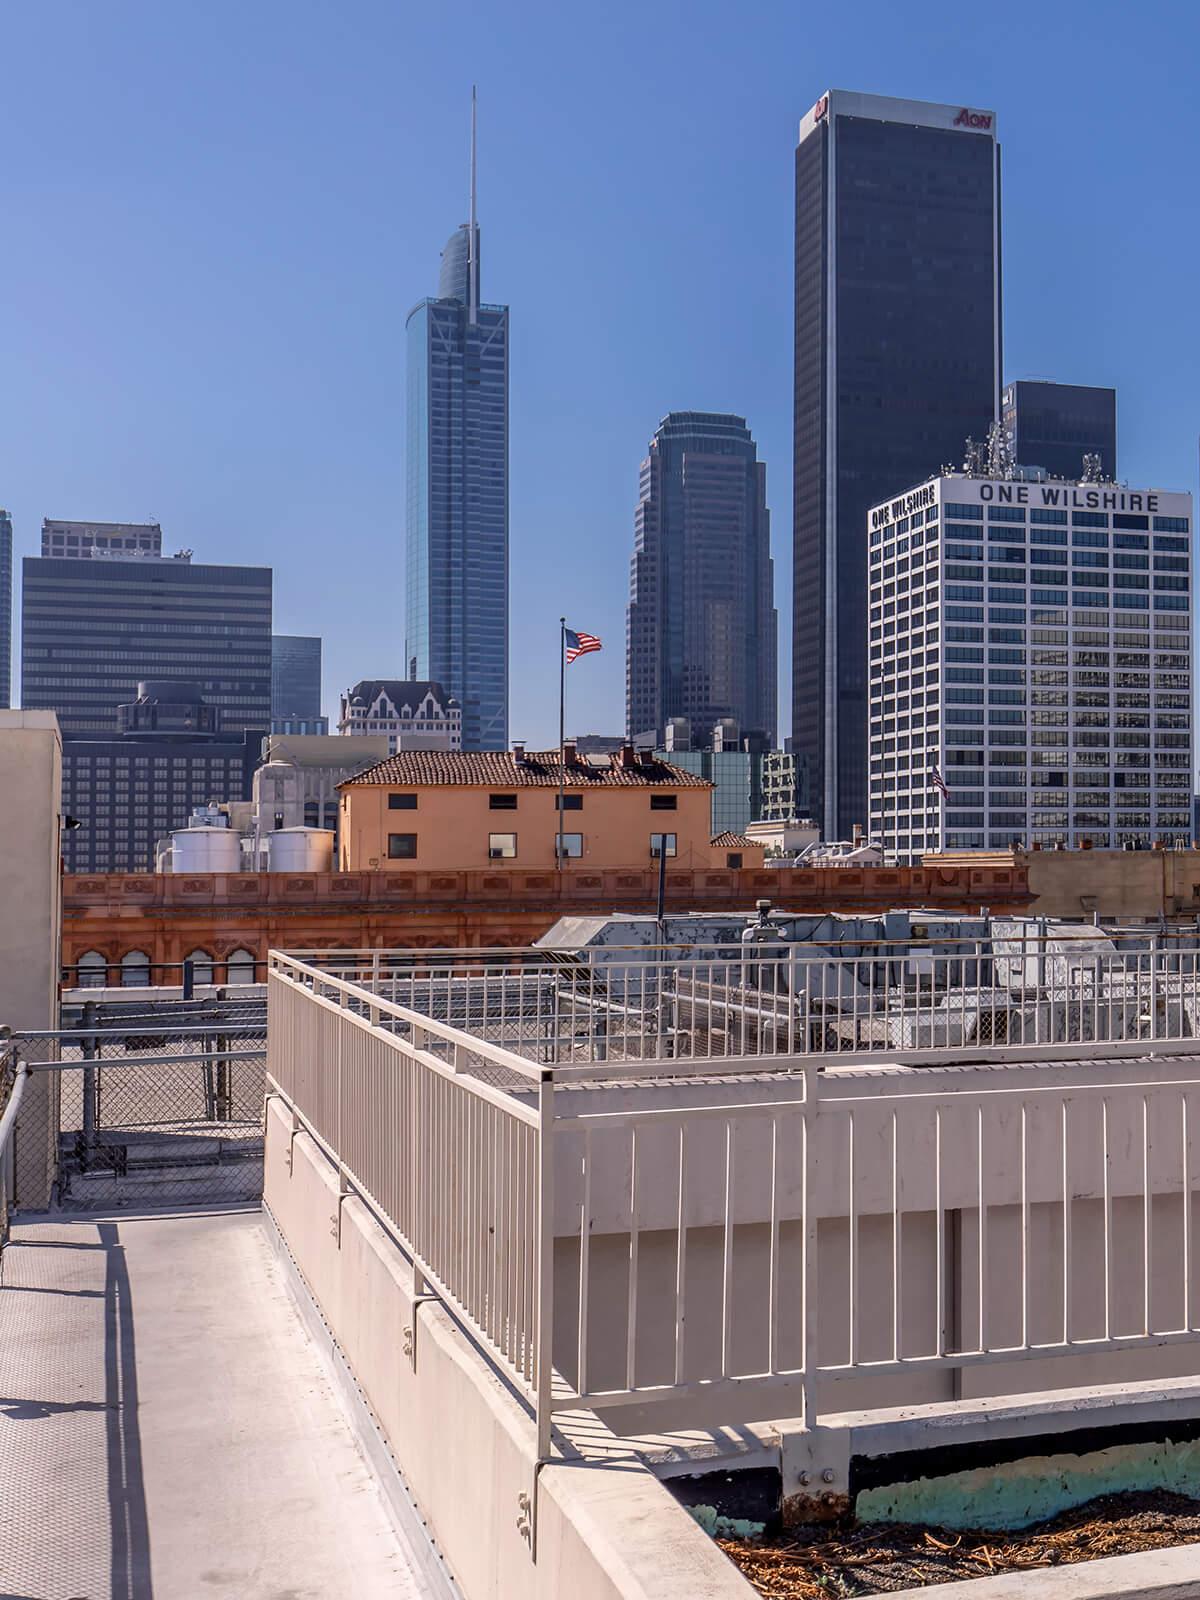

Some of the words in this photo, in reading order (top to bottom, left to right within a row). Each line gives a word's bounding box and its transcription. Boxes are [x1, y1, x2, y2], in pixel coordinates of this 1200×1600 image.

[872, 505, 890, 529] ONE
[891, 484, 936, 520] WILSHIRE
[980, 484, 1029, 504] ONE
[1041, 488, 1159, 513] WILSHIRE
